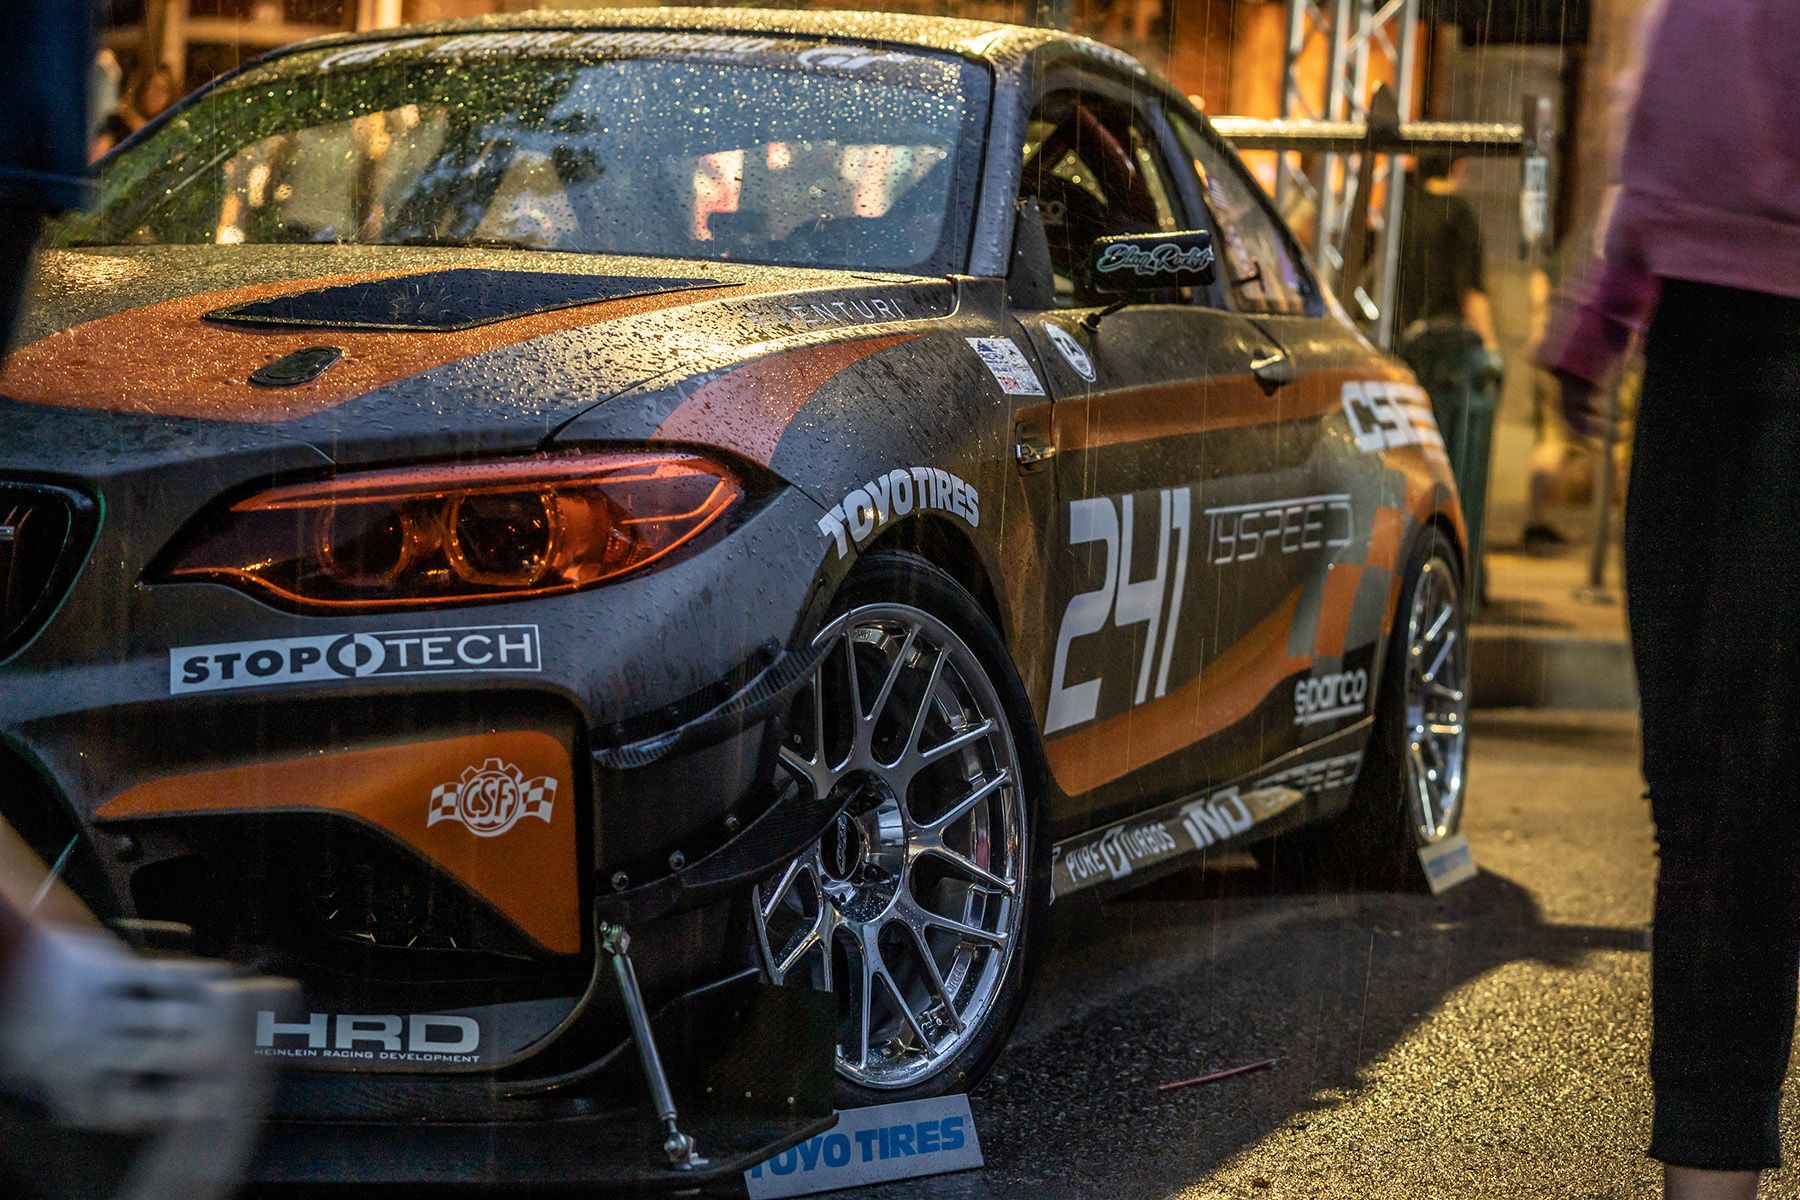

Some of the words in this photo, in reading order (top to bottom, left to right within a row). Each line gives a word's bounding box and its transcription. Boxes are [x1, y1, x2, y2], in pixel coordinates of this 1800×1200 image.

[818, 468, 914, 560] TOYO
[910, 467, 980, 528] TIRES
[1044, 487, 1190, 735] 241
[1294, 668, 1368, 727] sparco
[463, 777, 516, 823] CSF
[1065, 841, 1107, 883] PURE
[256, 1011, 480, 1054] HRD
[255, 1049, 317, 1057] HEINLEIN
[323, 1051, 374, 1059] RACING
[380, 1053, 481, 1063] DEVELOPMENT
[855, 1116, 965, 1163] TIRES
